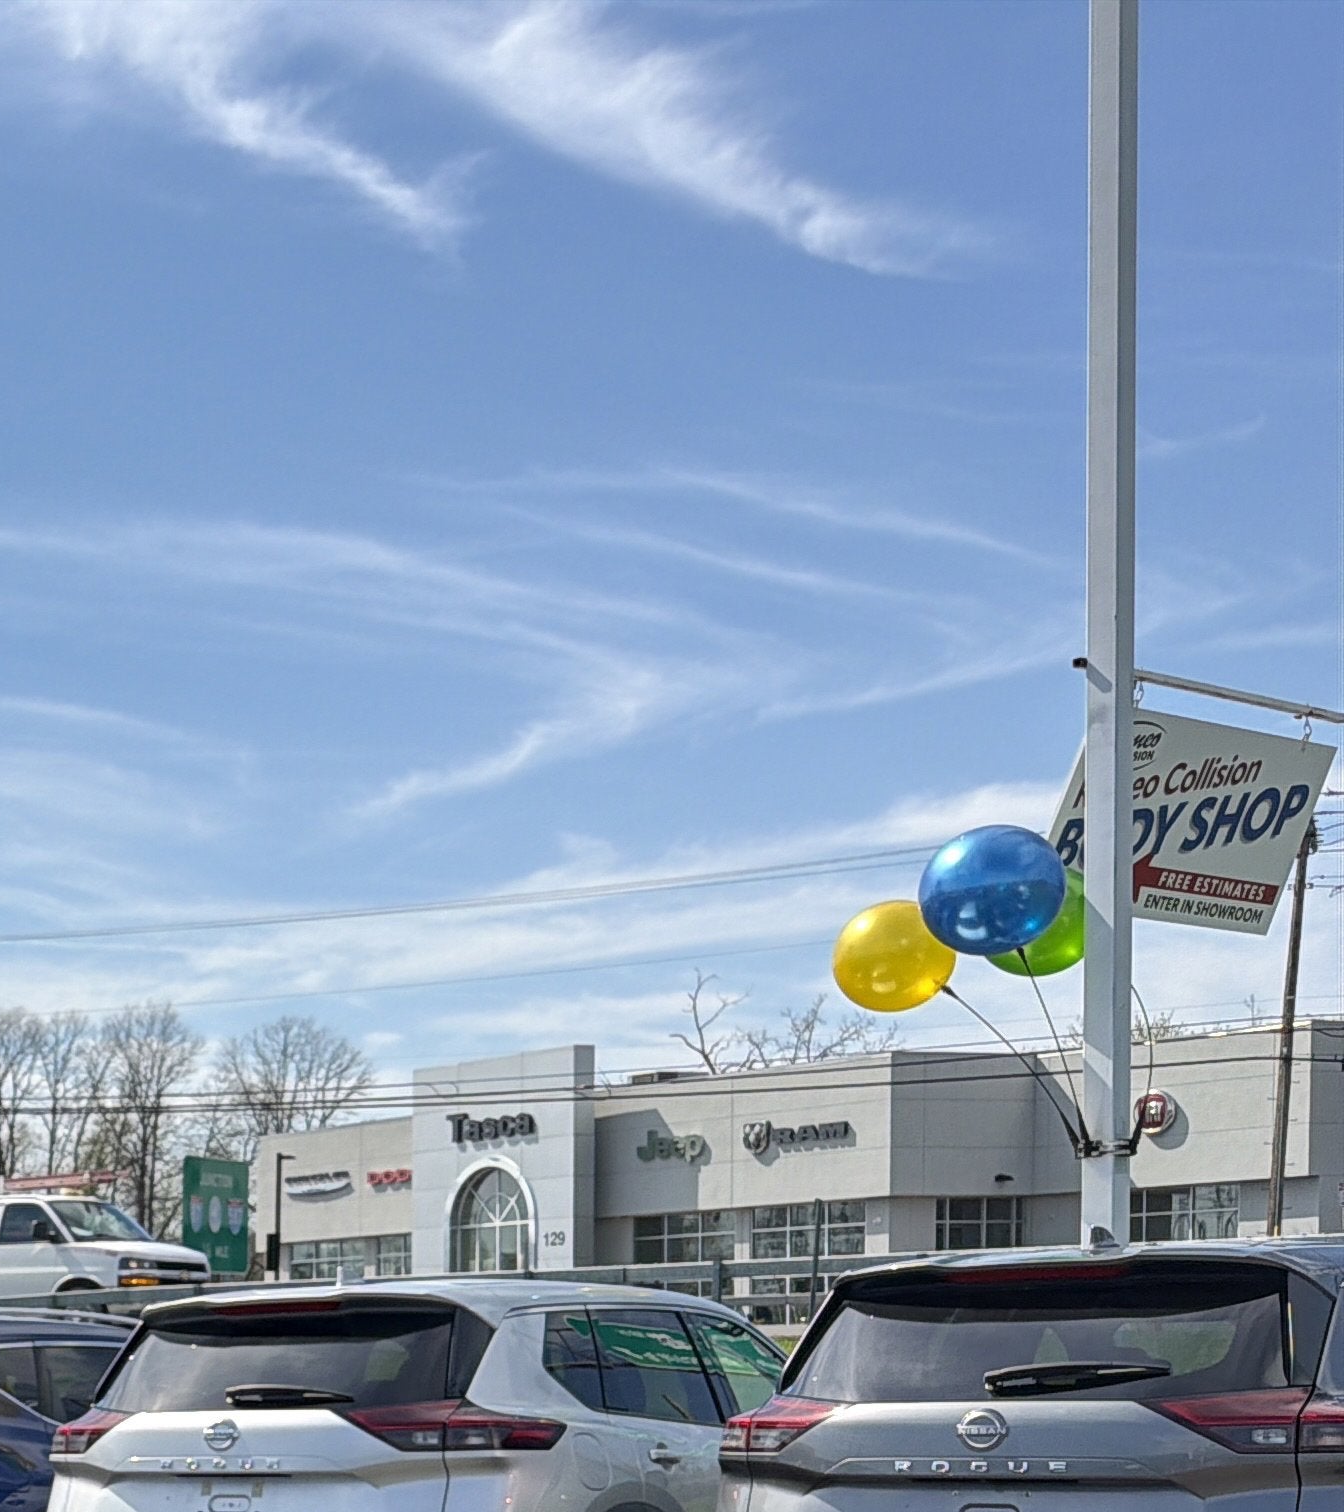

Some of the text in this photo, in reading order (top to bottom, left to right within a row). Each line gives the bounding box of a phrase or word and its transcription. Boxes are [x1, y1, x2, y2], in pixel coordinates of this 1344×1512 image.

[1164, 754, 1263, 795] Collision
[1056, 802, 1189, 867] BDY
[1179, 784, 1310, 853] SHOP
[1158, 871, 1266, 901] FREE ESTIMATES
[1143, 893, 1264, 924] ENTER IN SHOWROOM
[446, 1112, 536, 1143] Tasca
[773, 1121, 849, 1144] RAM
[637, 1130, 705, 1163] Jeep
[543, 1231, 566, 1247] 129
[894, 1460, 1067, 1473] ROGUE
